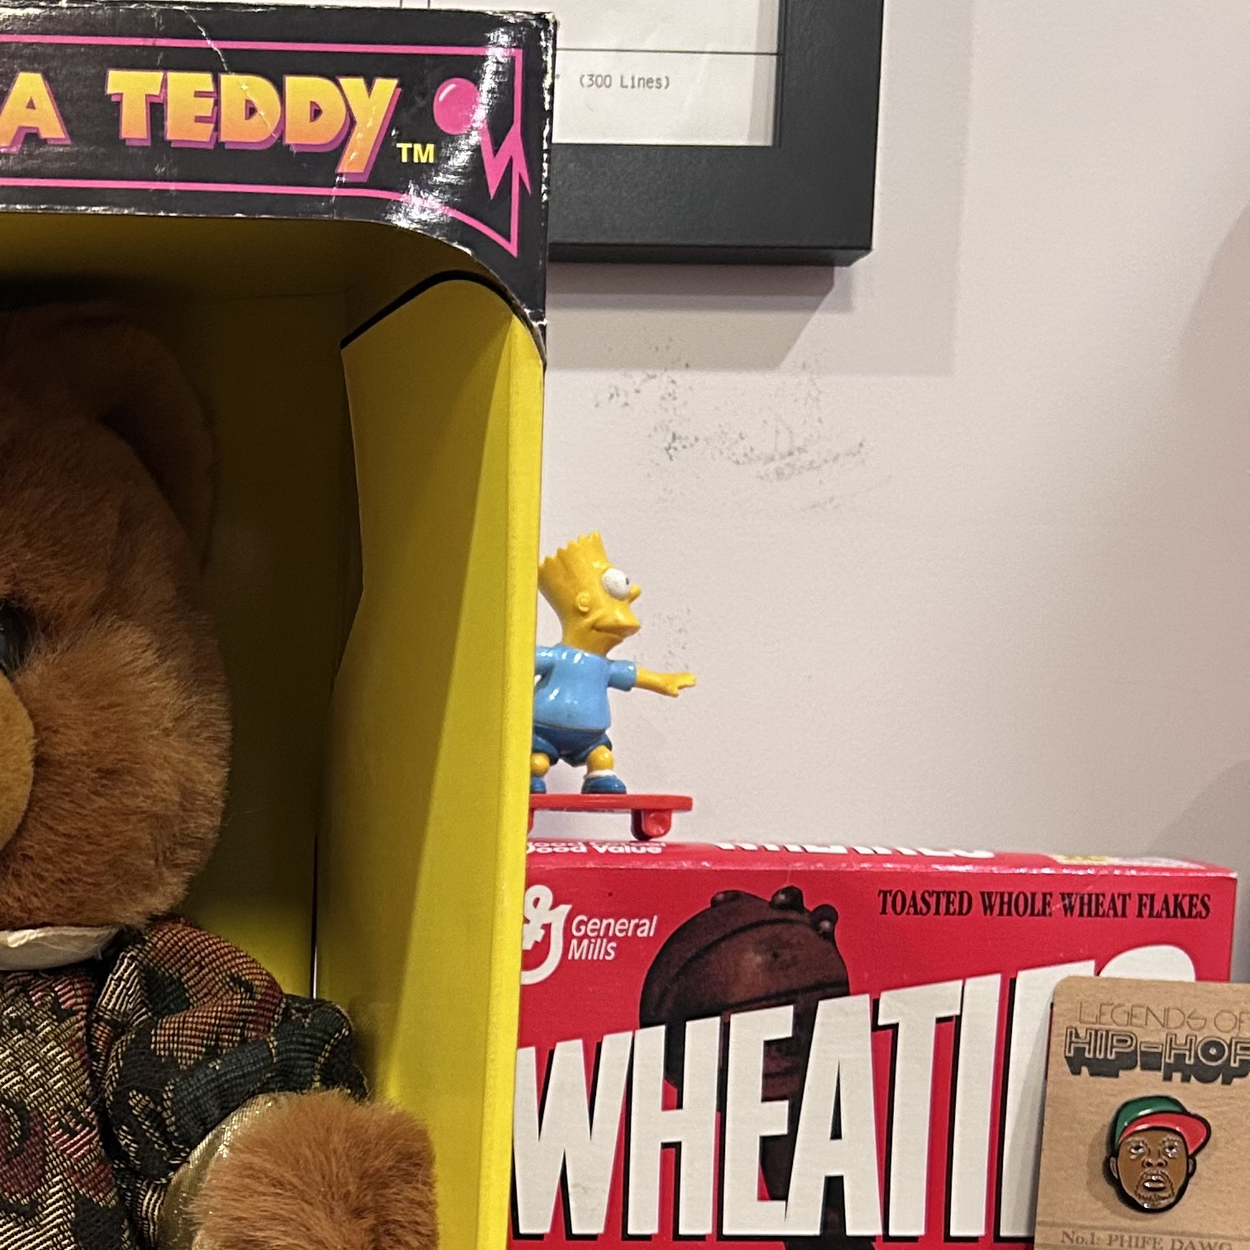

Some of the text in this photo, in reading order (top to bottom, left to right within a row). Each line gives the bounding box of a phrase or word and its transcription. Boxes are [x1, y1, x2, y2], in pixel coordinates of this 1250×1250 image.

[579, 74, 670, 90] (300 Lines)
[106, 69, 401, 182] TEDDY
[396, 143, 436, 164] TM
[878, 889, 1212, 920] TOASTED WHOLE WHEAT FLAKES
[571, 914, 659, 938] General
[567, 938, 618, 961] Mills
[1078, 1001, 1207, 1032] LEGENDS
[1106, 1233, 1164, 1250] PHIFE
